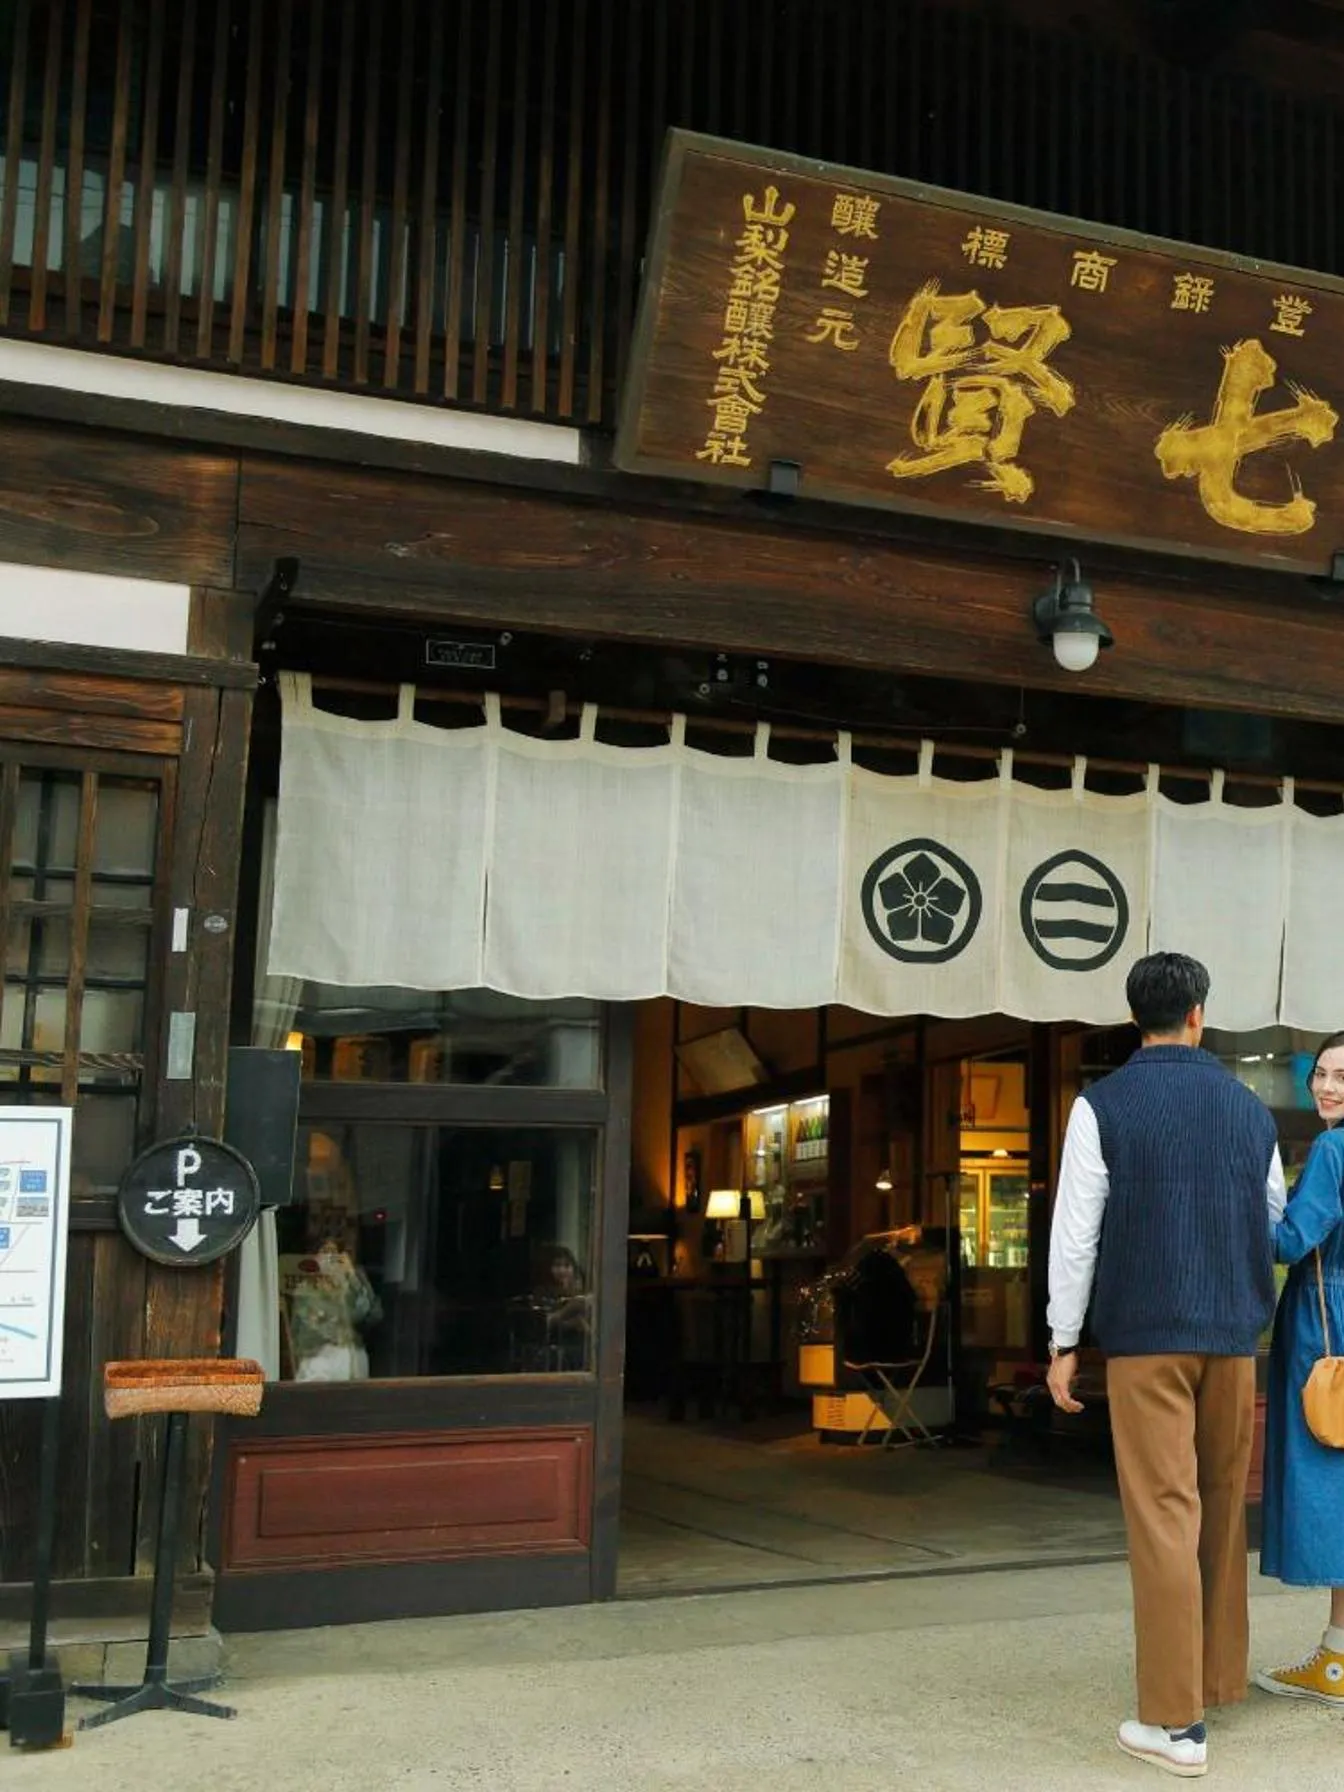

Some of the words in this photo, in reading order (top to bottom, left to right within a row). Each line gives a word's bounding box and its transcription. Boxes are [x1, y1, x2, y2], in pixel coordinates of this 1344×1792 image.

[176, 1149, 202, 1187] P
[143, 1187, 235, 1216] ご案内
